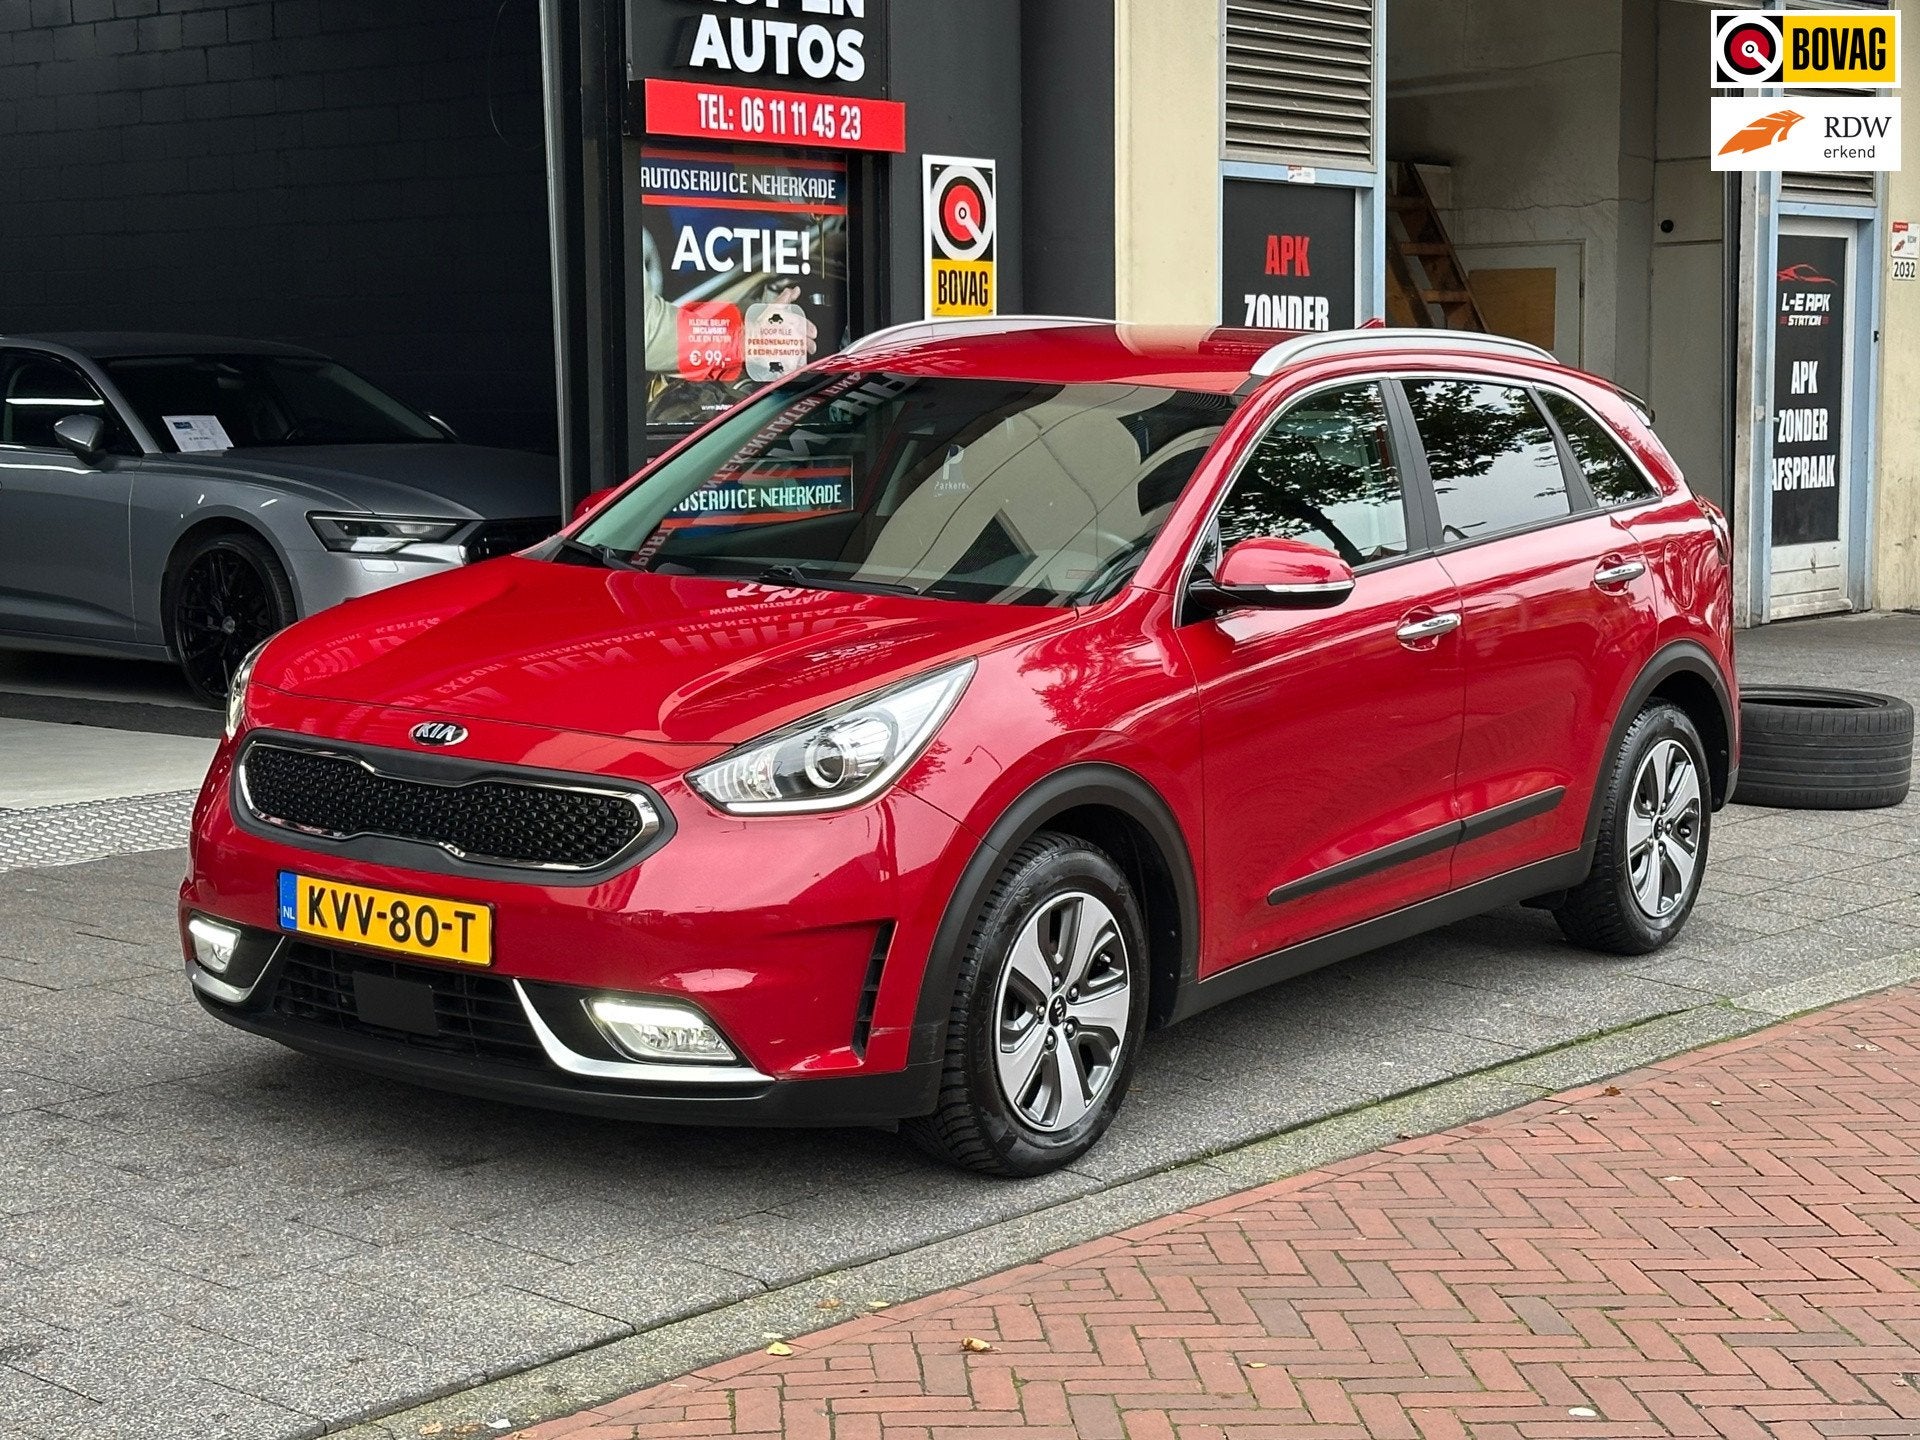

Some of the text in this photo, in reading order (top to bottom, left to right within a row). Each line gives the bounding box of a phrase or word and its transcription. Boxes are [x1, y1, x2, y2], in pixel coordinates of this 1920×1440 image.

[689, 14, 865, 82] AUTOS
[697, 93, 862, 141] TEL: 06 11 11 45 23
[641, 166, 836, 199] AUTOSERVICE NEHERKADE
[671, 225, 811, 276] ACTIE!
[1265, 235, 1310, 277] APK
[1894, 261, 1915, 278] 2032
[937, 269, 989, 307] BOVAG
[1781, 292, 1831, 312] L-E APK
[1244, 293, 1329, 332] ZONDER
[1788, 314, 1822, 326] STATION
[1791, 360, 1818, 394] APK
[1778, 408, 1828, 443] ZONDER
[760, 484, 842, 508] NEHERKADE
[415, 723, 457, 742] KIA
[283, 885, 476, 954] NL KVV-80-T
